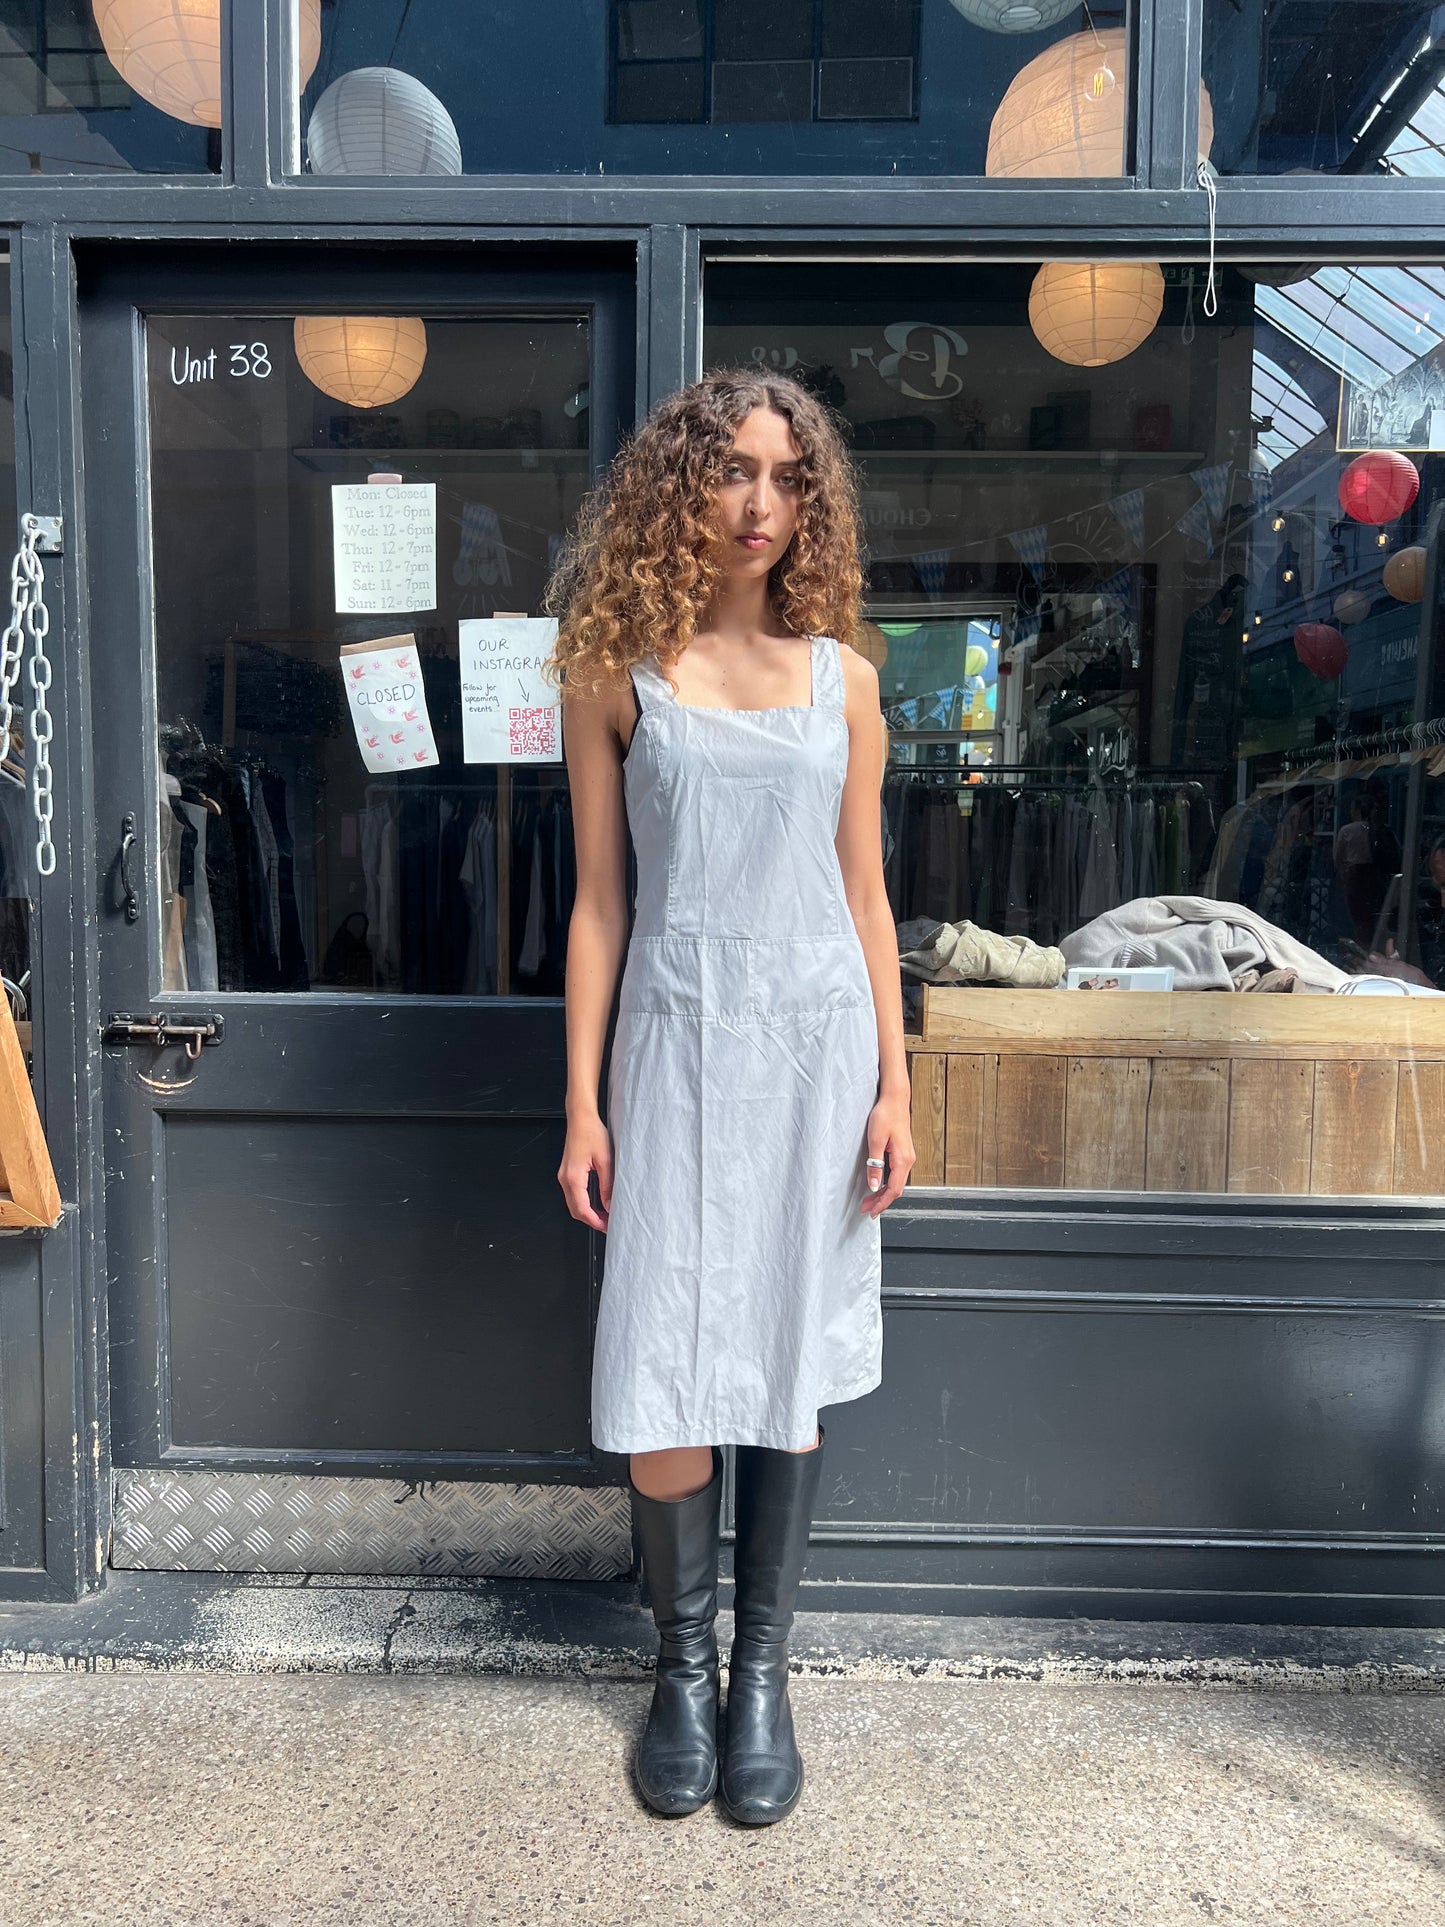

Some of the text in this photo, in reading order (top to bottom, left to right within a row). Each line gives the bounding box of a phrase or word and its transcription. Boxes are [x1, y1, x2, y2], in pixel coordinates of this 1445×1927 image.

[171, 342, 272, 385] Unit 38
[347, 487, 427, 500] Mon: Closed
[345, 506, 375, 518] Tue:
[344, 524, 379, 537] Wed:
[341, 543, 373, 555] Thu:
[352, 560, 375, 573] Fri:
[352, 578, 376, 591] Sat:
[347, 596, 376, 609] Sun:
[478, 638, 510, 652] OUR
[473, 656, 547, 671] INSTAGRA
[357, 683, 416, 706] CLOSED
[463, 683, 497, 697] Follow for
[464, 695, 500, 708] upcoming
